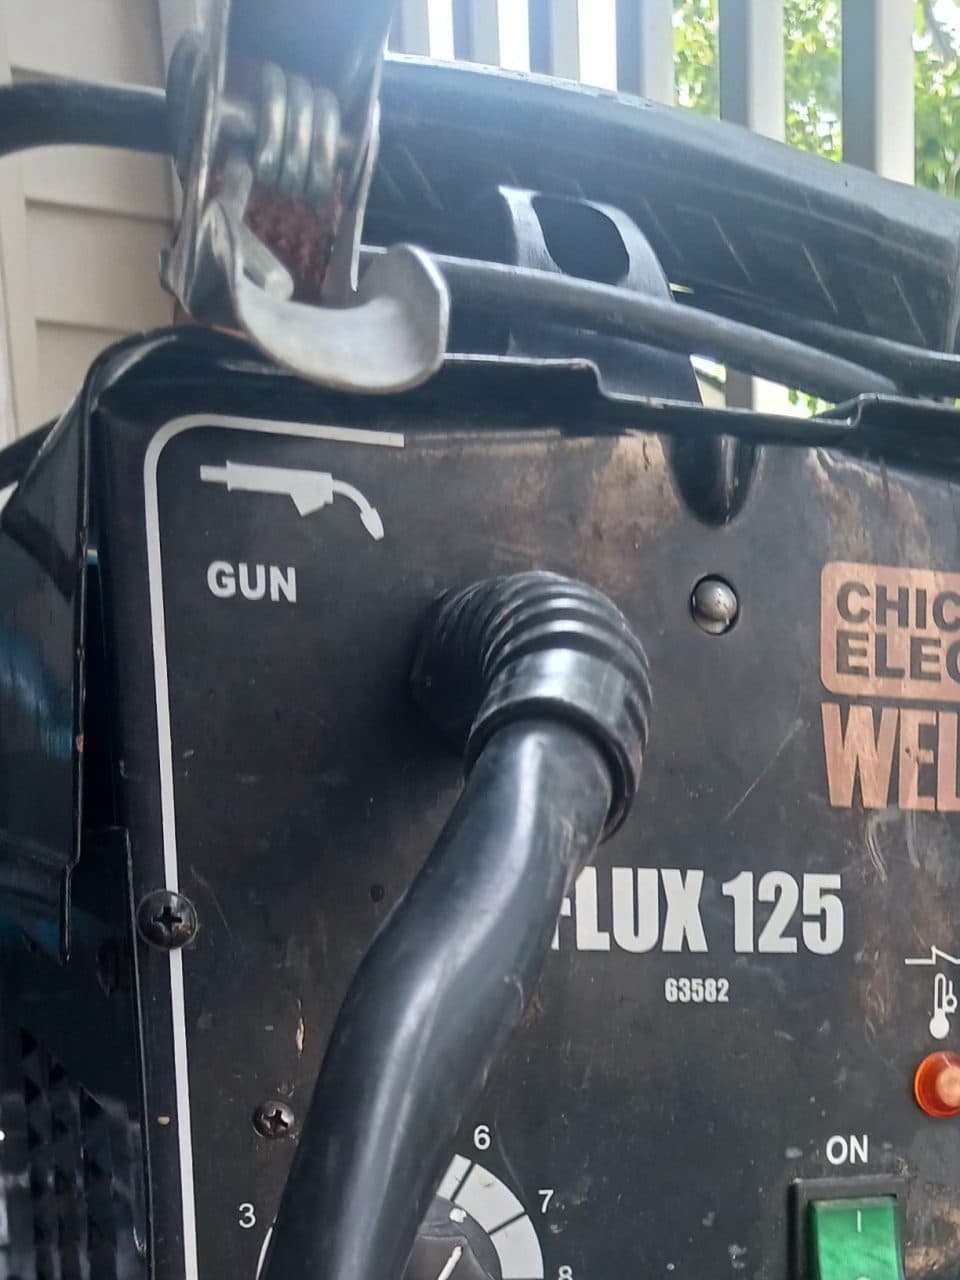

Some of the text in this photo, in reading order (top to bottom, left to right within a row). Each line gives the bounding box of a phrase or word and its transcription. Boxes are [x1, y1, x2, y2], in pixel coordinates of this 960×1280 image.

[206, 560, 297, 603] GUN
[551, 866, 844, 955] LUX 125
[665, 978, 729, 1003] 63582
[473, 1125, 491, 1150] 6
[826, 1135, 869, 1165] ON
[538, 1190, 554, 1214] 7
[238, 1203, 256, 1229] 3
